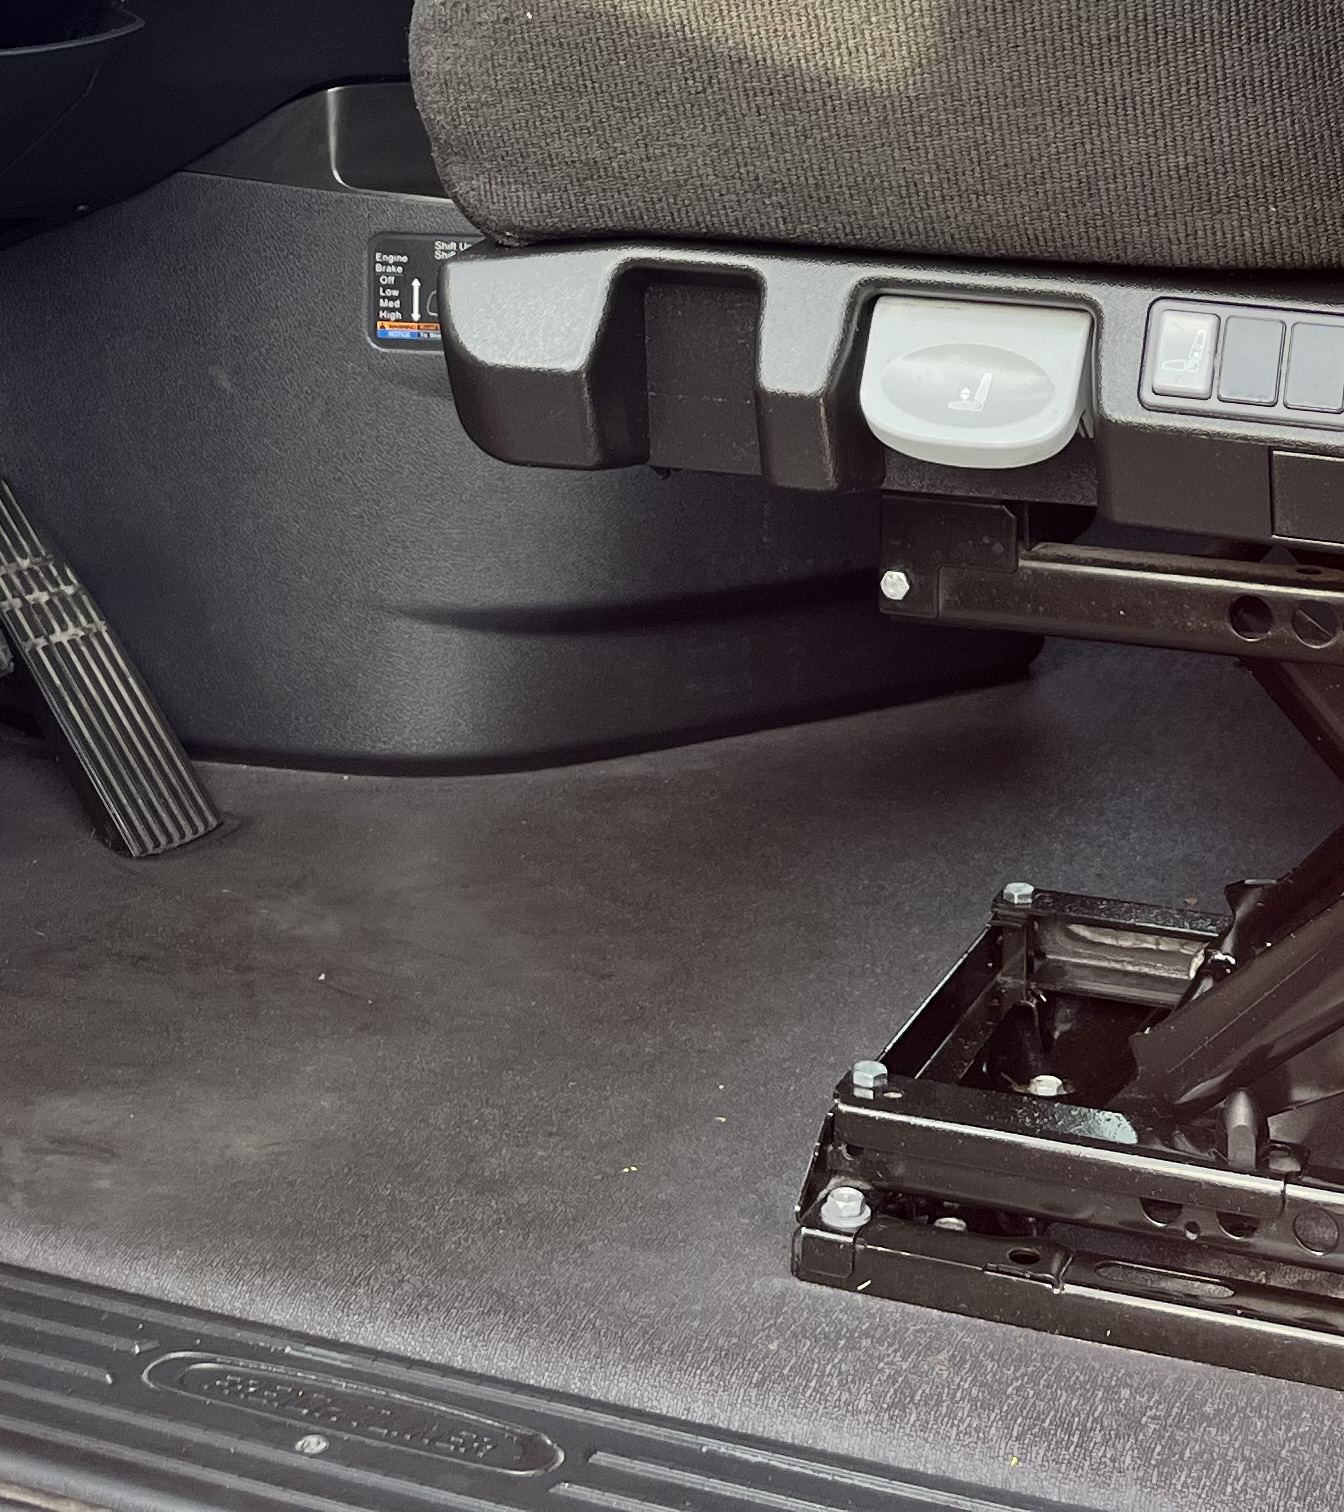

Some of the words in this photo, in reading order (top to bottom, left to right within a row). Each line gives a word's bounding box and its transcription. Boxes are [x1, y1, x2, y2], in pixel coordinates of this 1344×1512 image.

[375, 252, 408, 263] Engine
[375, 264, 403, 273] Brake
[380, 276, 395, 285] Off
[380, 288, 399, 297] Low
[379, 299, 400, 308] Med
[379, 310, 402, 320] High
